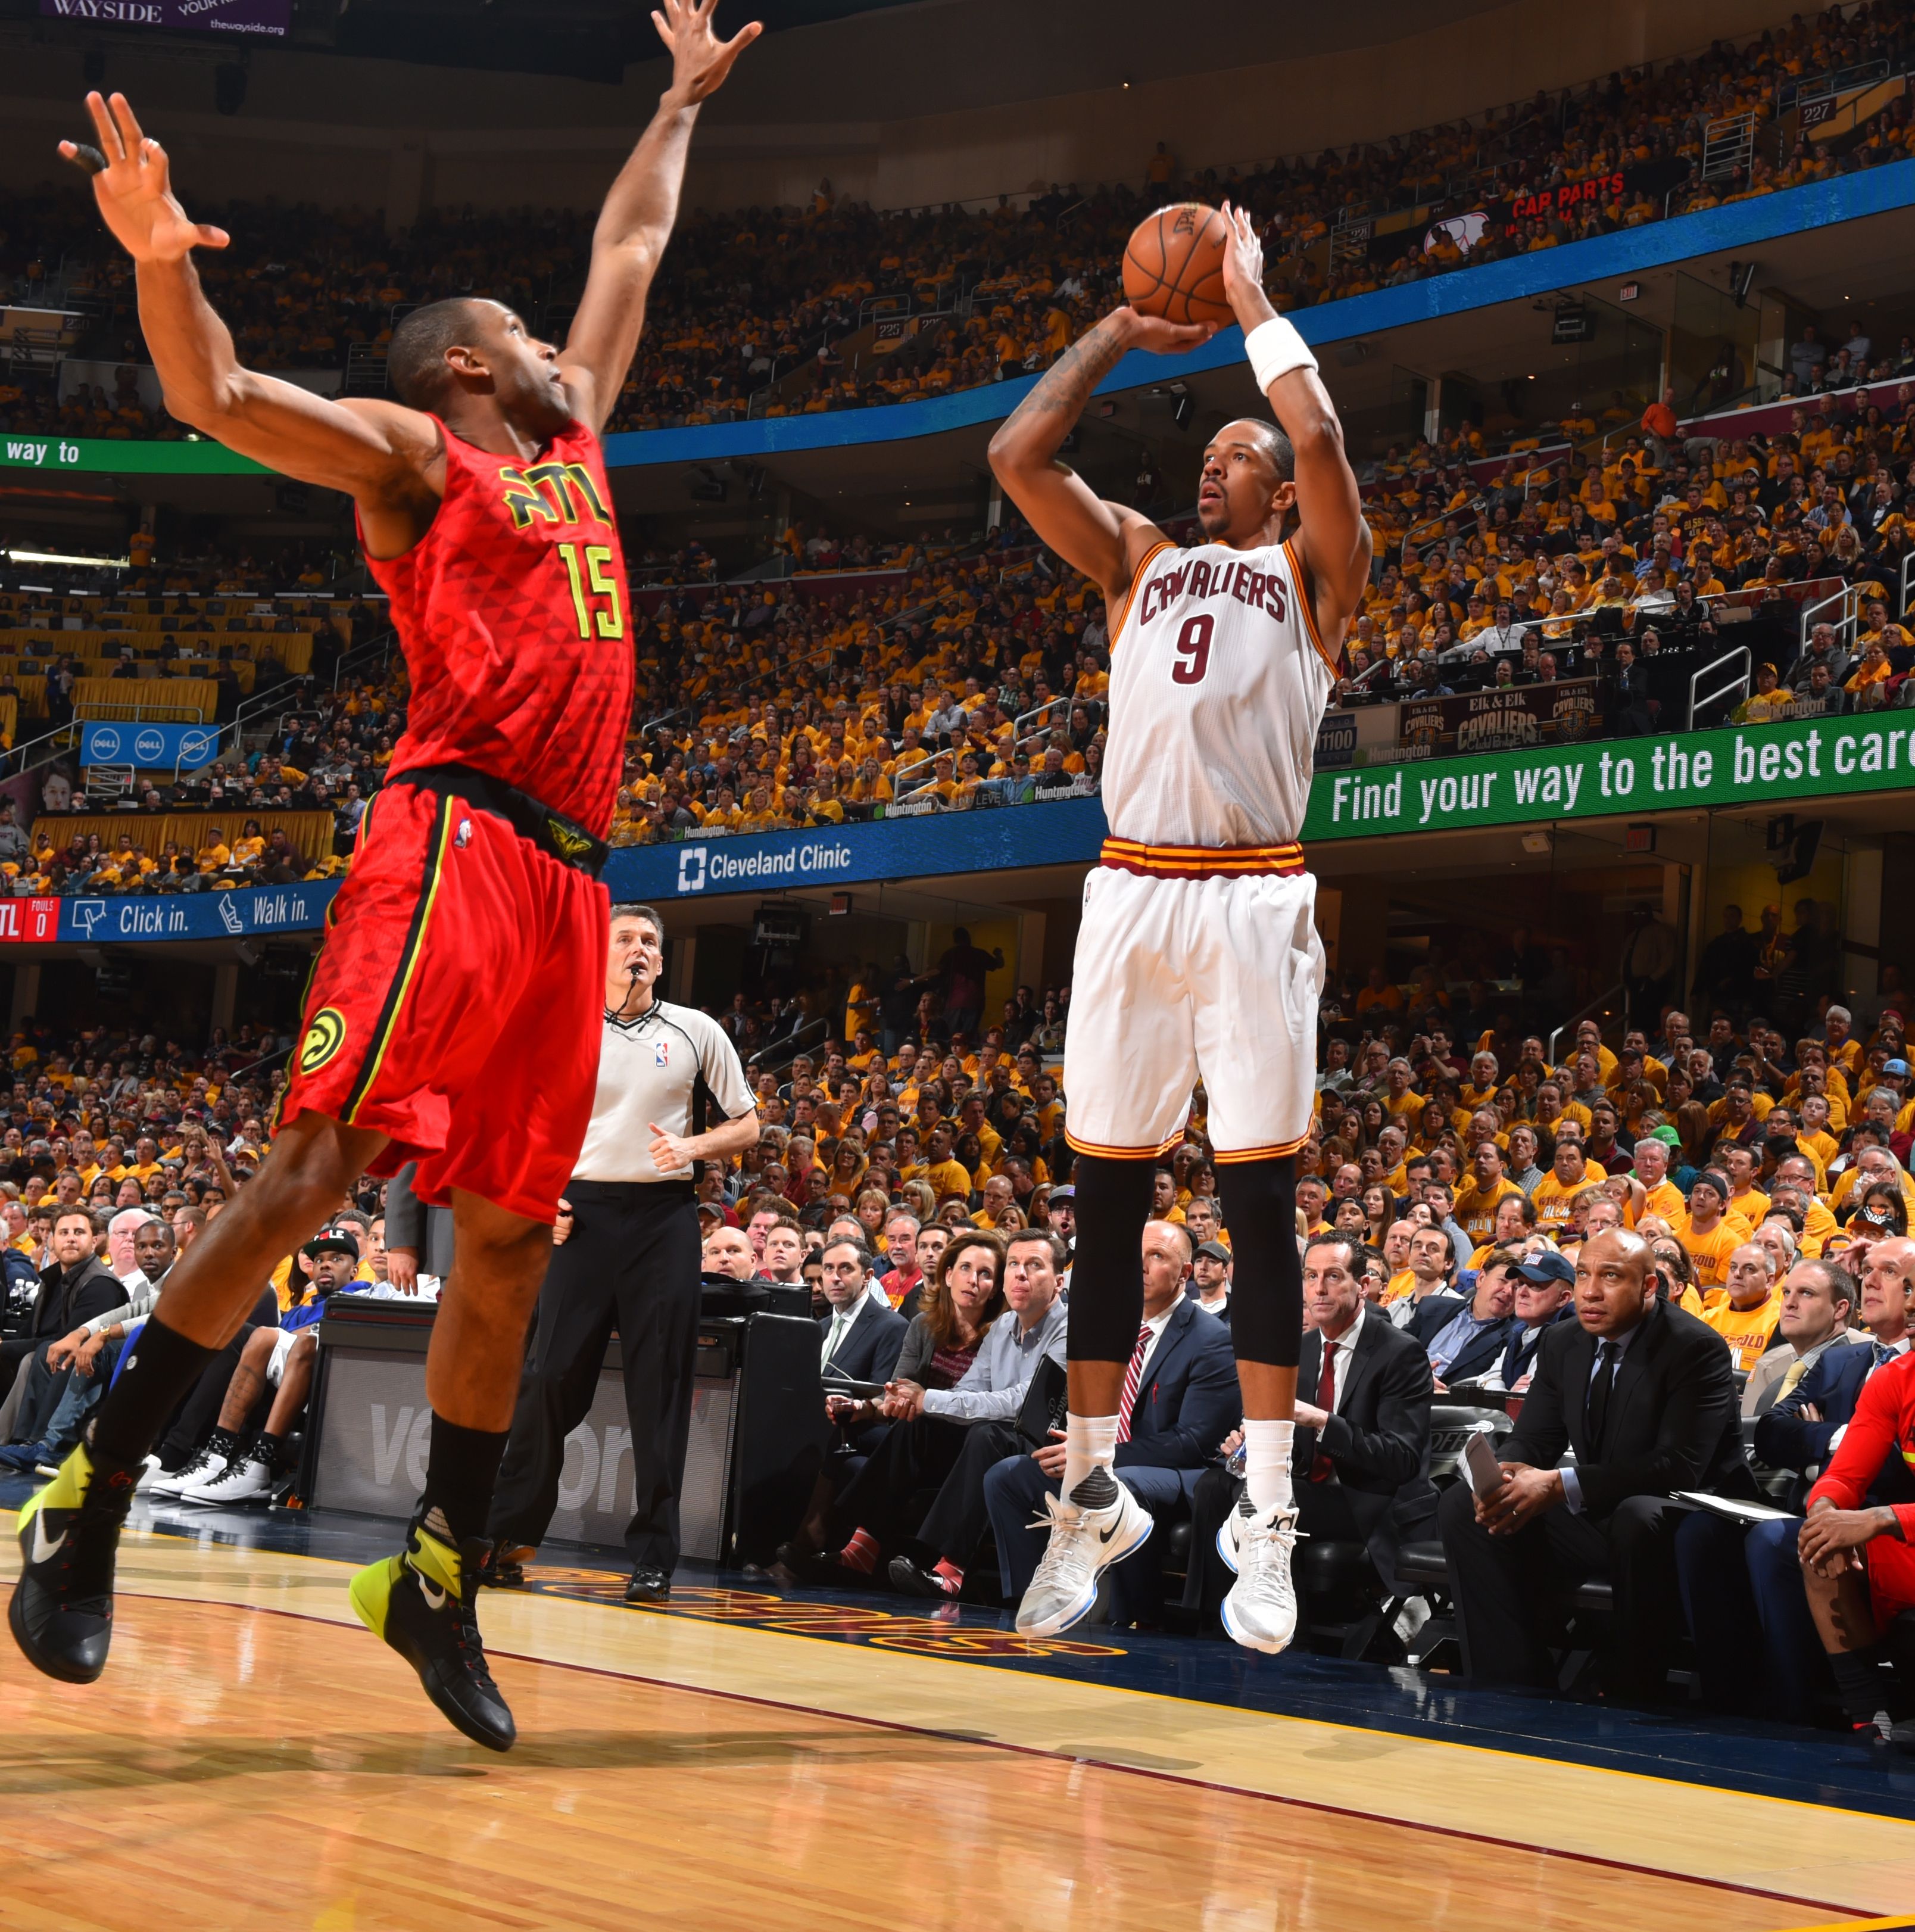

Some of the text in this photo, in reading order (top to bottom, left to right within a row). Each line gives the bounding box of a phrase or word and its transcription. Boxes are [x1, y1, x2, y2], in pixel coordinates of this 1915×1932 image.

[54, 0, 162, 23] WAYSIDE
[210, 19, 285, 35] thewayside.org
[1804, 102, 1830, 123] 227
[1558, 172, 1625, 208] PARTS
[7, 441, 79, 465] way to
[499, 462, 613, 530] ATL
[558, 543, 623, 639] 15
[1140, 559, 1286, 626] CAVALIERS
[1171, 613, 1215, 685] 9
[1469, 691, 1527, 711] Elk & Elk
[1552, 696, 1595, 718] CAVALIERS
[1323, 718, 1350, 727] ADIO
[1405, 714, 1445, 736] CAVALIERS
[1457, 710, 1537, 751] CAVALIERS
[94, 739, 117, 748] DELL
[138, 740, 161, 749] DELL
[1370, 744, 1431, 762] Huntington
[1332, 771, 1402, 822] Find
[1418, 772, 1498, 824] your
[1513, 764, 1584, 811] way
[1598, 752, 1635, 796] to
[1651, 742, 1713, 792] the
[1733, 730, 1822, 784] best
[1034, 784, 1086, 800] Huntington
[885, 802, 932, 817] Huntington
[684, 825, 725, 839] Huntington
[710, 842, 852, 879] Cleveland Clinic
[32, 900, 54, 912] FOULS
[254, 893, 309, 926] Walk in.
[0, 904, 19, 936] TL
[36, 913, 46, 937] 0
[120, 904, 189, 933] Click in.
[1736, 1333, 1765, 1349] GOLD
[1046, 1383, 1068, 1435] PALDIN
[370, 1403, 638, 1516] veon
